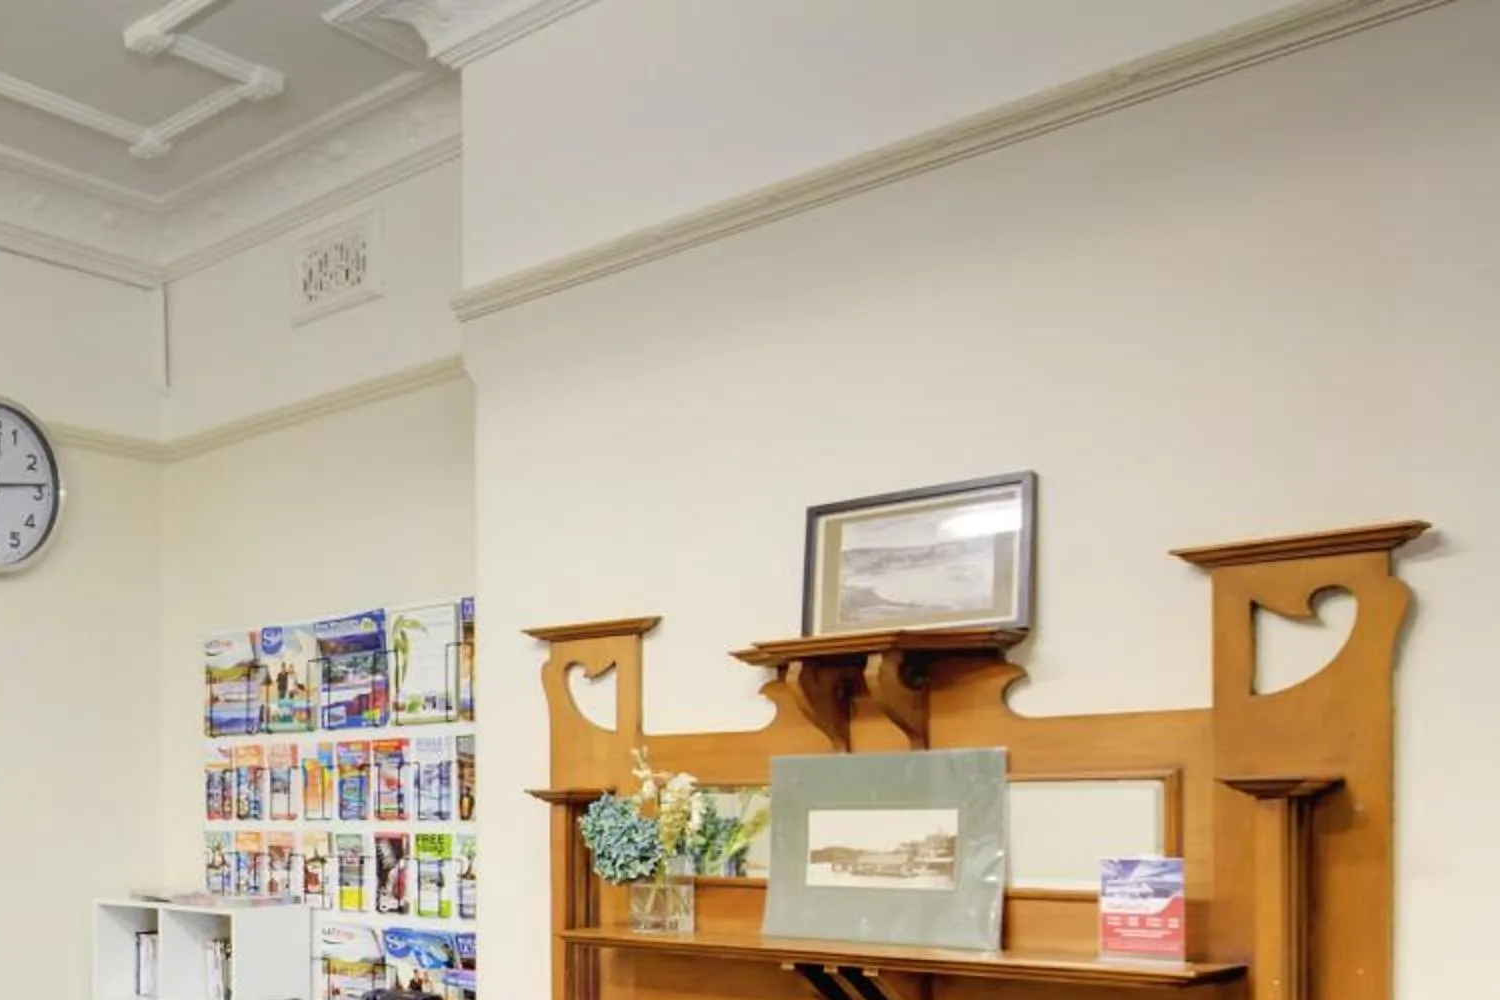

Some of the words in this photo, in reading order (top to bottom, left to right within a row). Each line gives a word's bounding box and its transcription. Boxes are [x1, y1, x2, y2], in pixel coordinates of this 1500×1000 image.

[12, 429, 18, 446] 1
[26, 455, 37, 471] 2
[32, 483, 44, 501] 3
[24, 514, 36, 528] 4
[9, 532, 20, 548] 5
[415, 833, 445, 845] FREE
